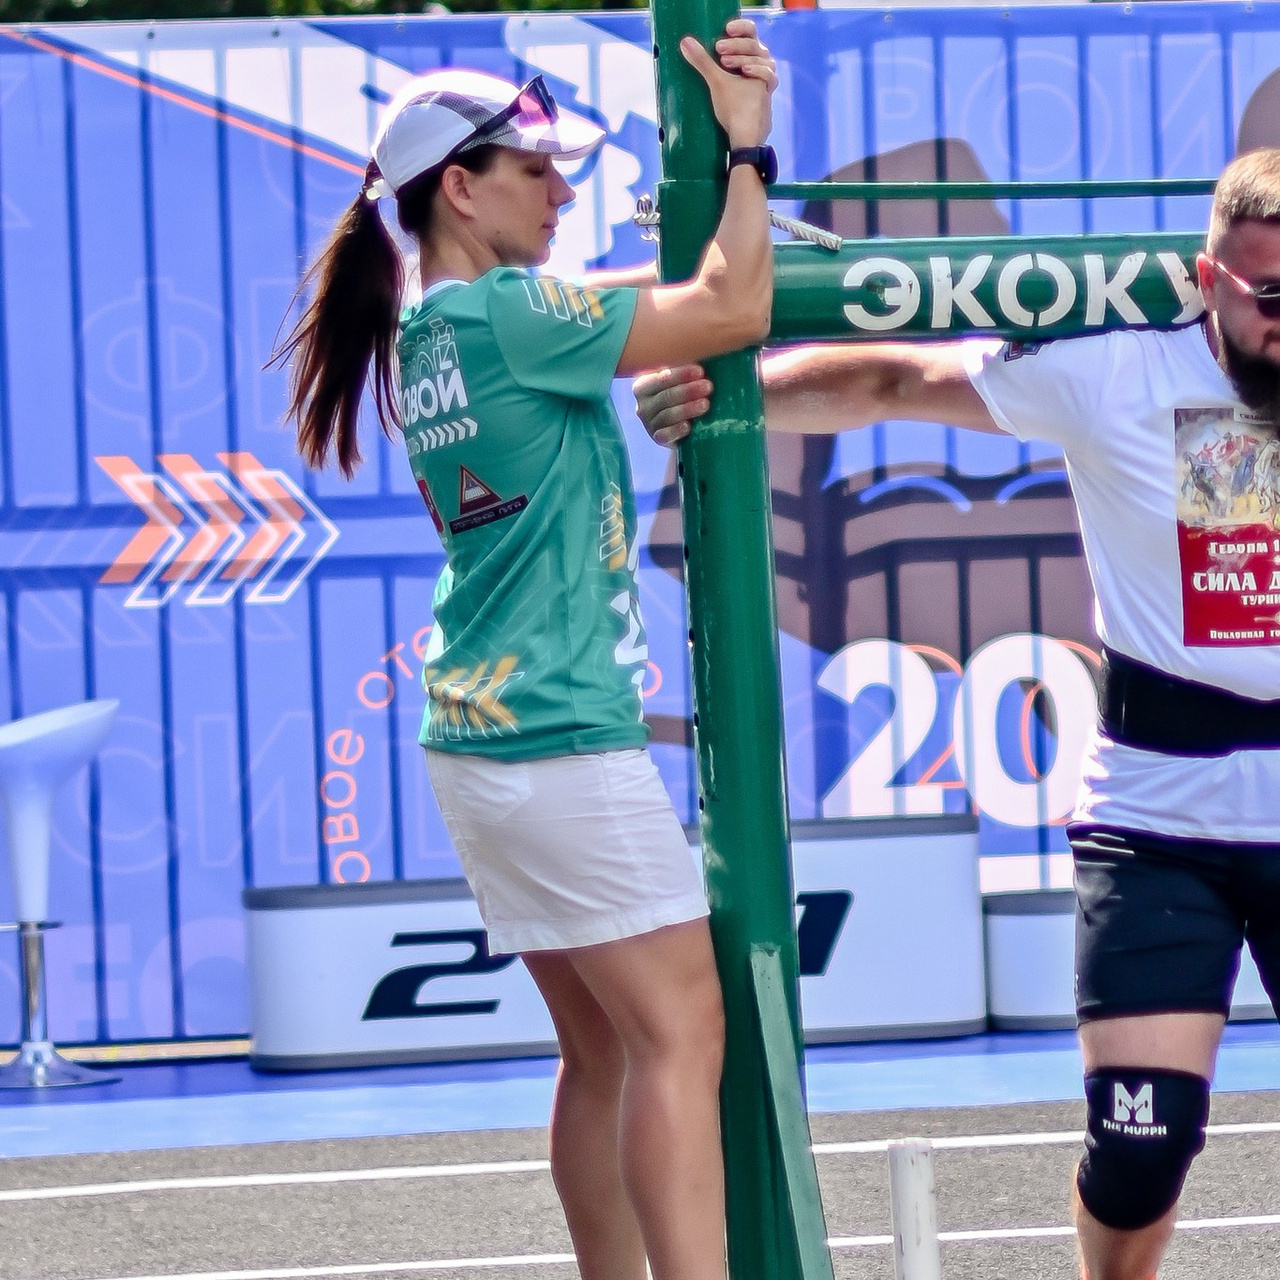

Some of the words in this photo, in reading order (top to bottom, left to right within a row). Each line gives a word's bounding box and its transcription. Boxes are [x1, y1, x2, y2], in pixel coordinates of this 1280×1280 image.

[1192, 571, 1257, 592] СИЛА
[361, 928, 521, 1023] 2
[1102, 1119, 1121, 1132] THE
[1123, 1124, 1168, 1136] MURPH
